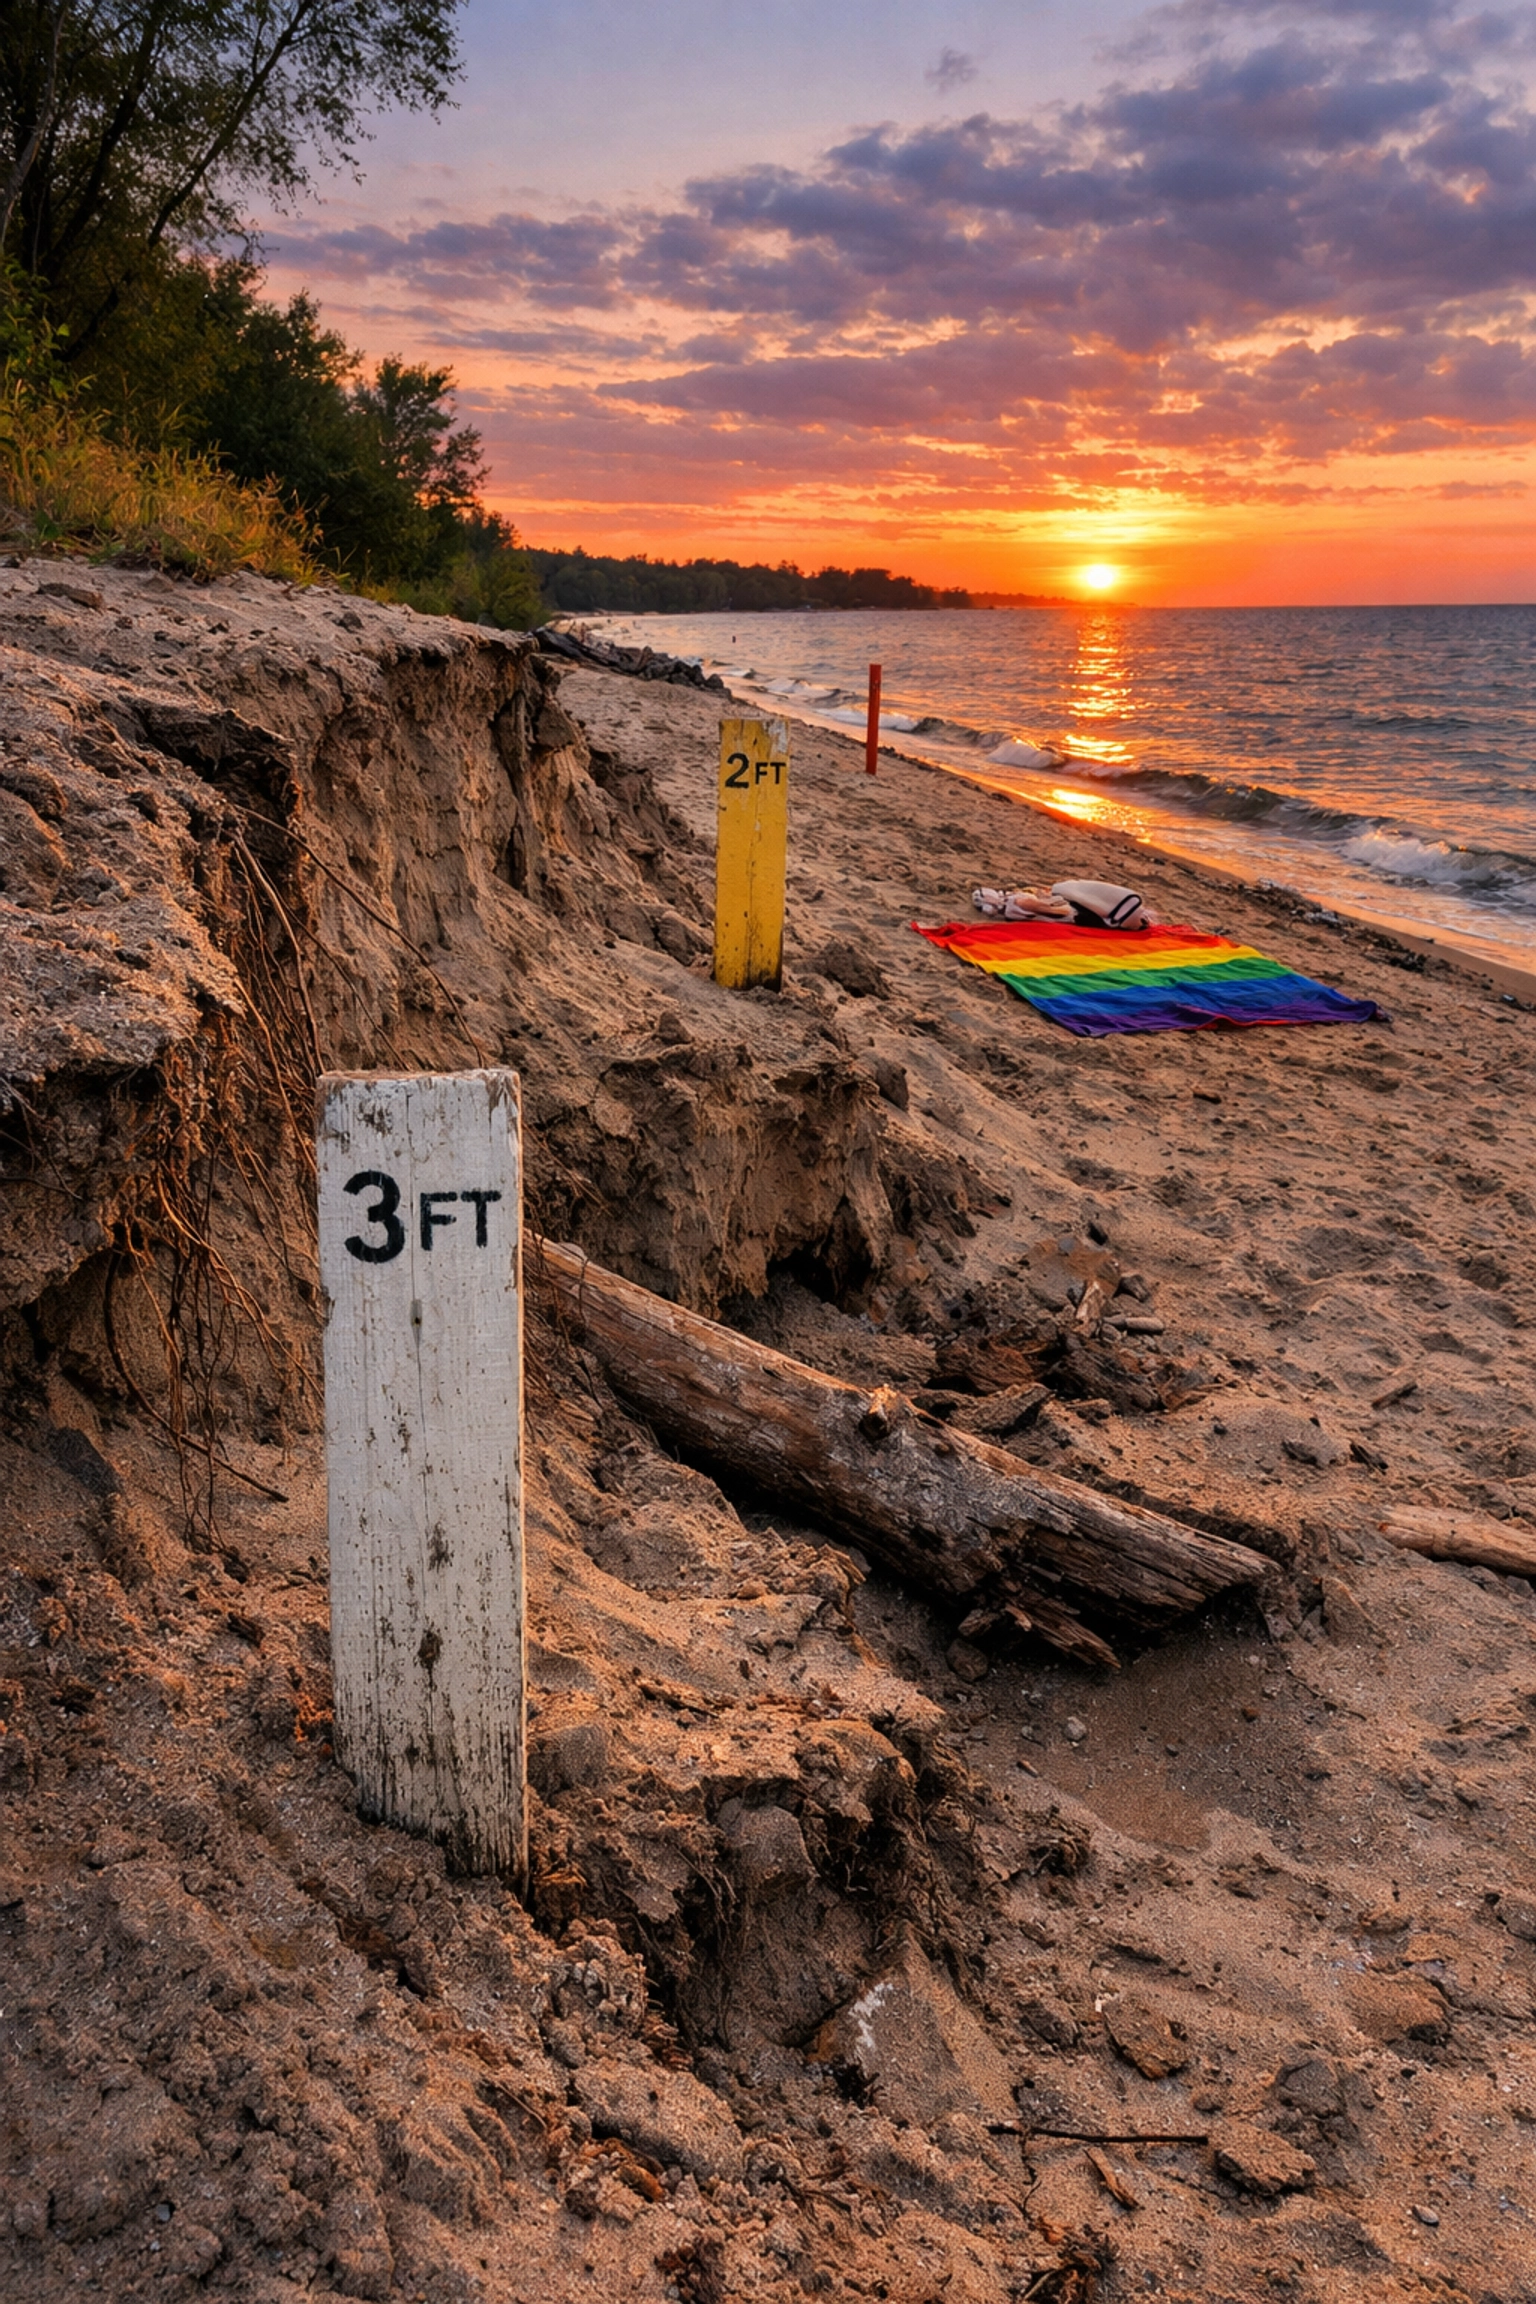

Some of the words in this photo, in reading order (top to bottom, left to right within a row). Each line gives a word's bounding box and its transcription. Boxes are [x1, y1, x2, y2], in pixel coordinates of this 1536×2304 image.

[725, 752, 750, 789] 2
[755, 762, 787, 785] FT
[343, 1170, 405, 1264] 3
[420, 1190, 502, 1251] FT
